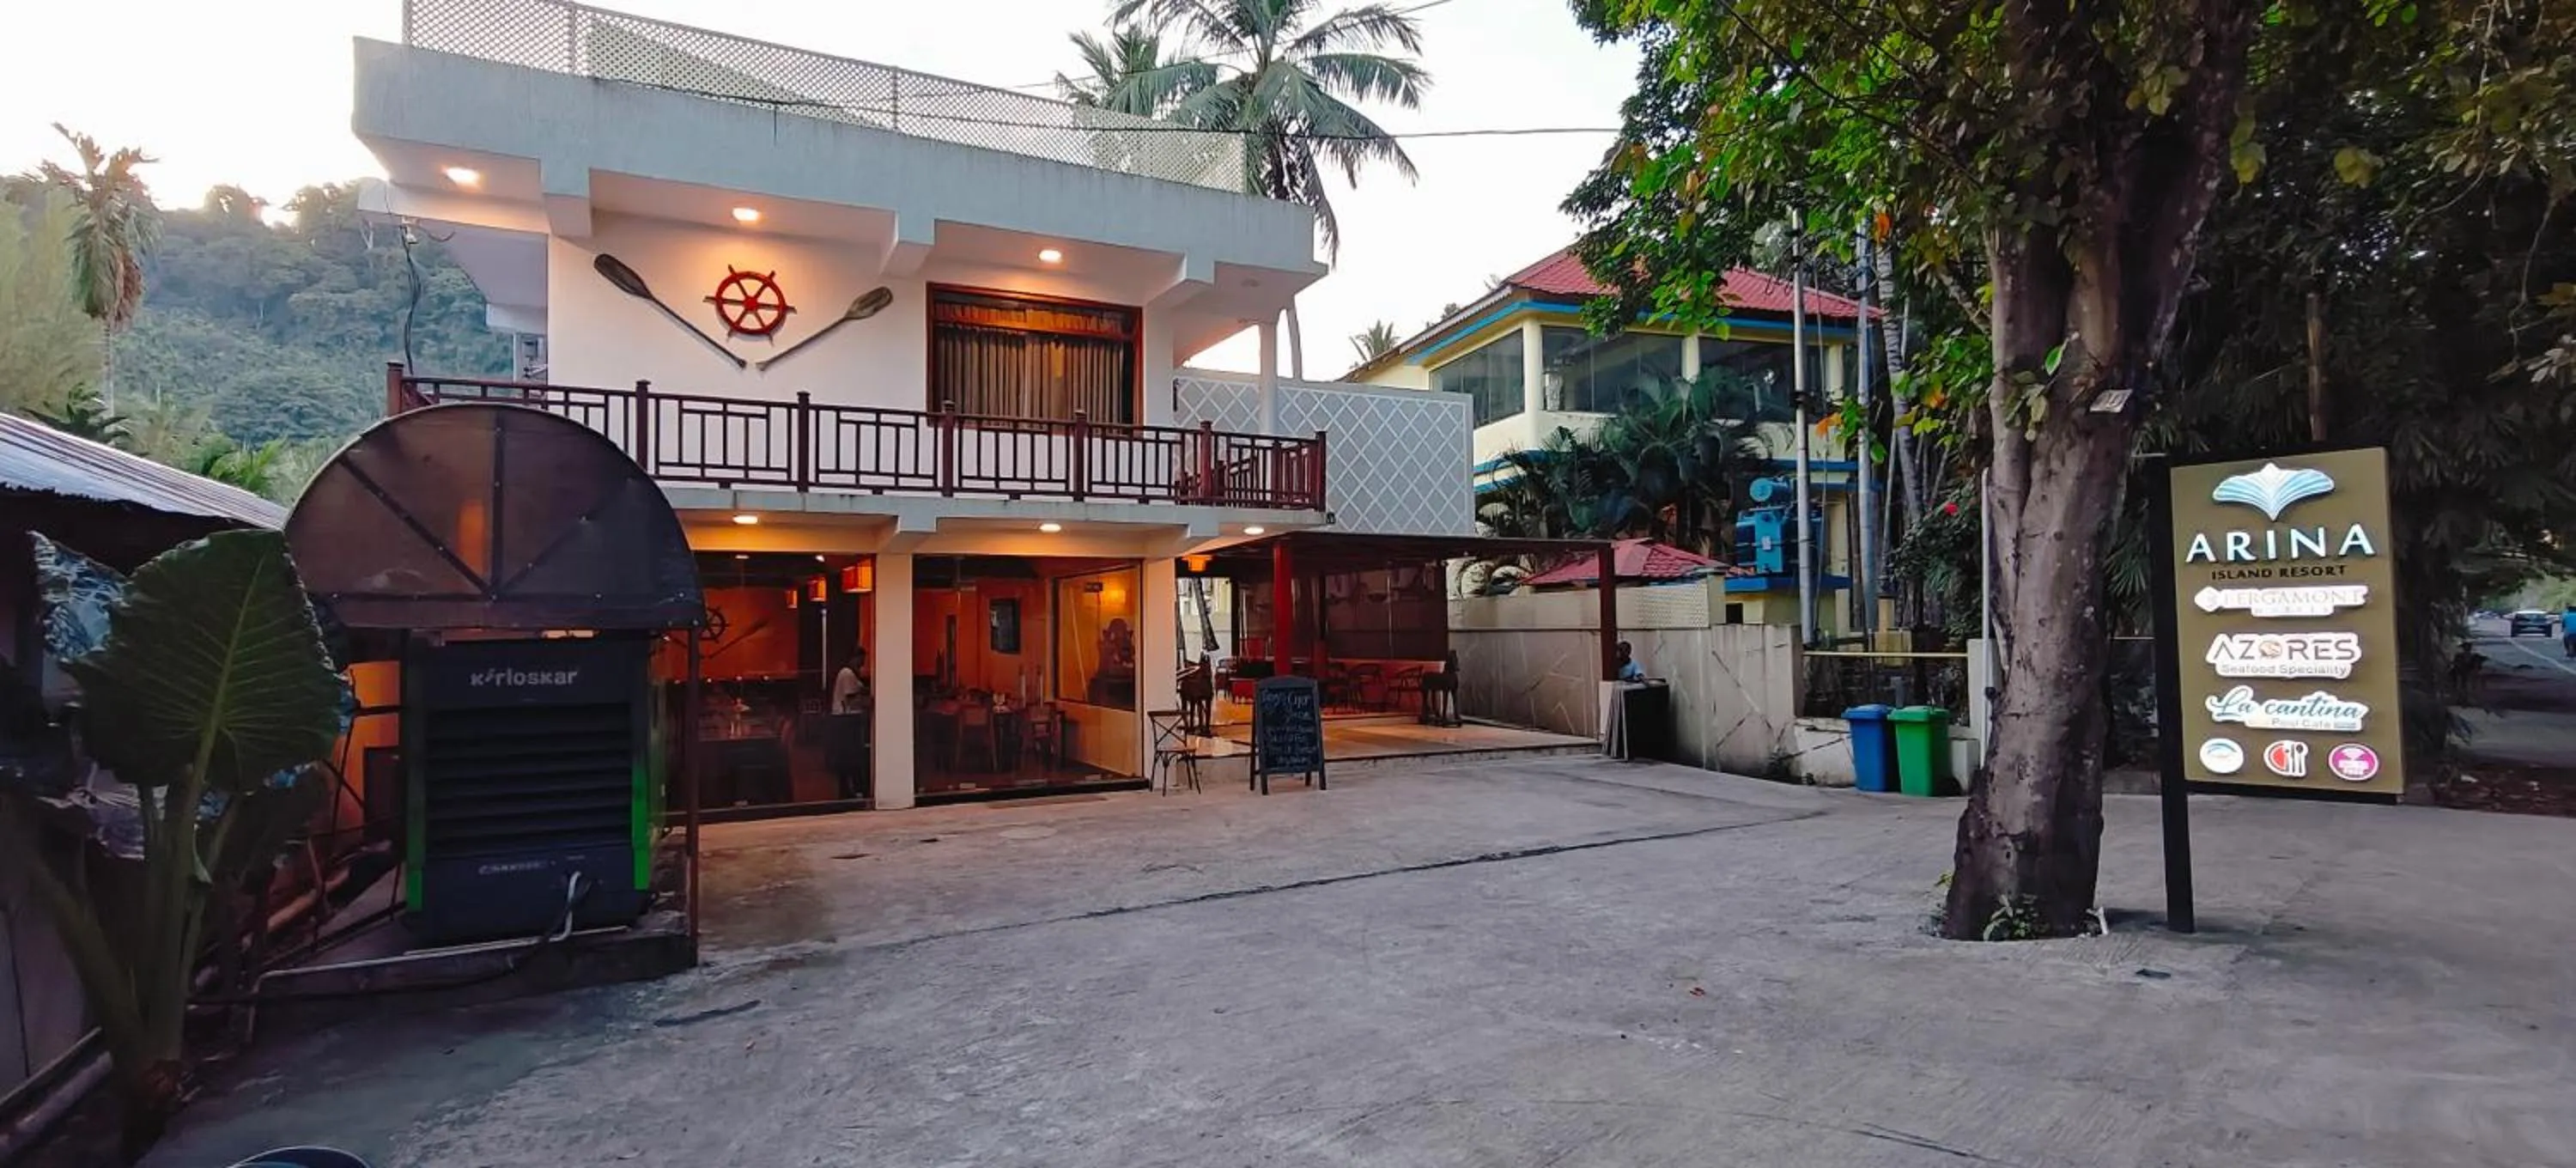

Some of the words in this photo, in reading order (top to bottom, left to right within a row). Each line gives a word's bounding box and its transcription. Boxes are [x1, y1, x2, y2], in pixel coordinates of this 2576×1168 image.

[2185, 523, 2376, 563] ARINA
[2211, 567, 2273, 581] ISLAND
[2279, 564, 2348, 578] RESORT
[2213, 639, 2355, 660] AZORES
[2221, 663, 2276, 674] Seafood
[2279, 663, 2348, 677] Speciality
